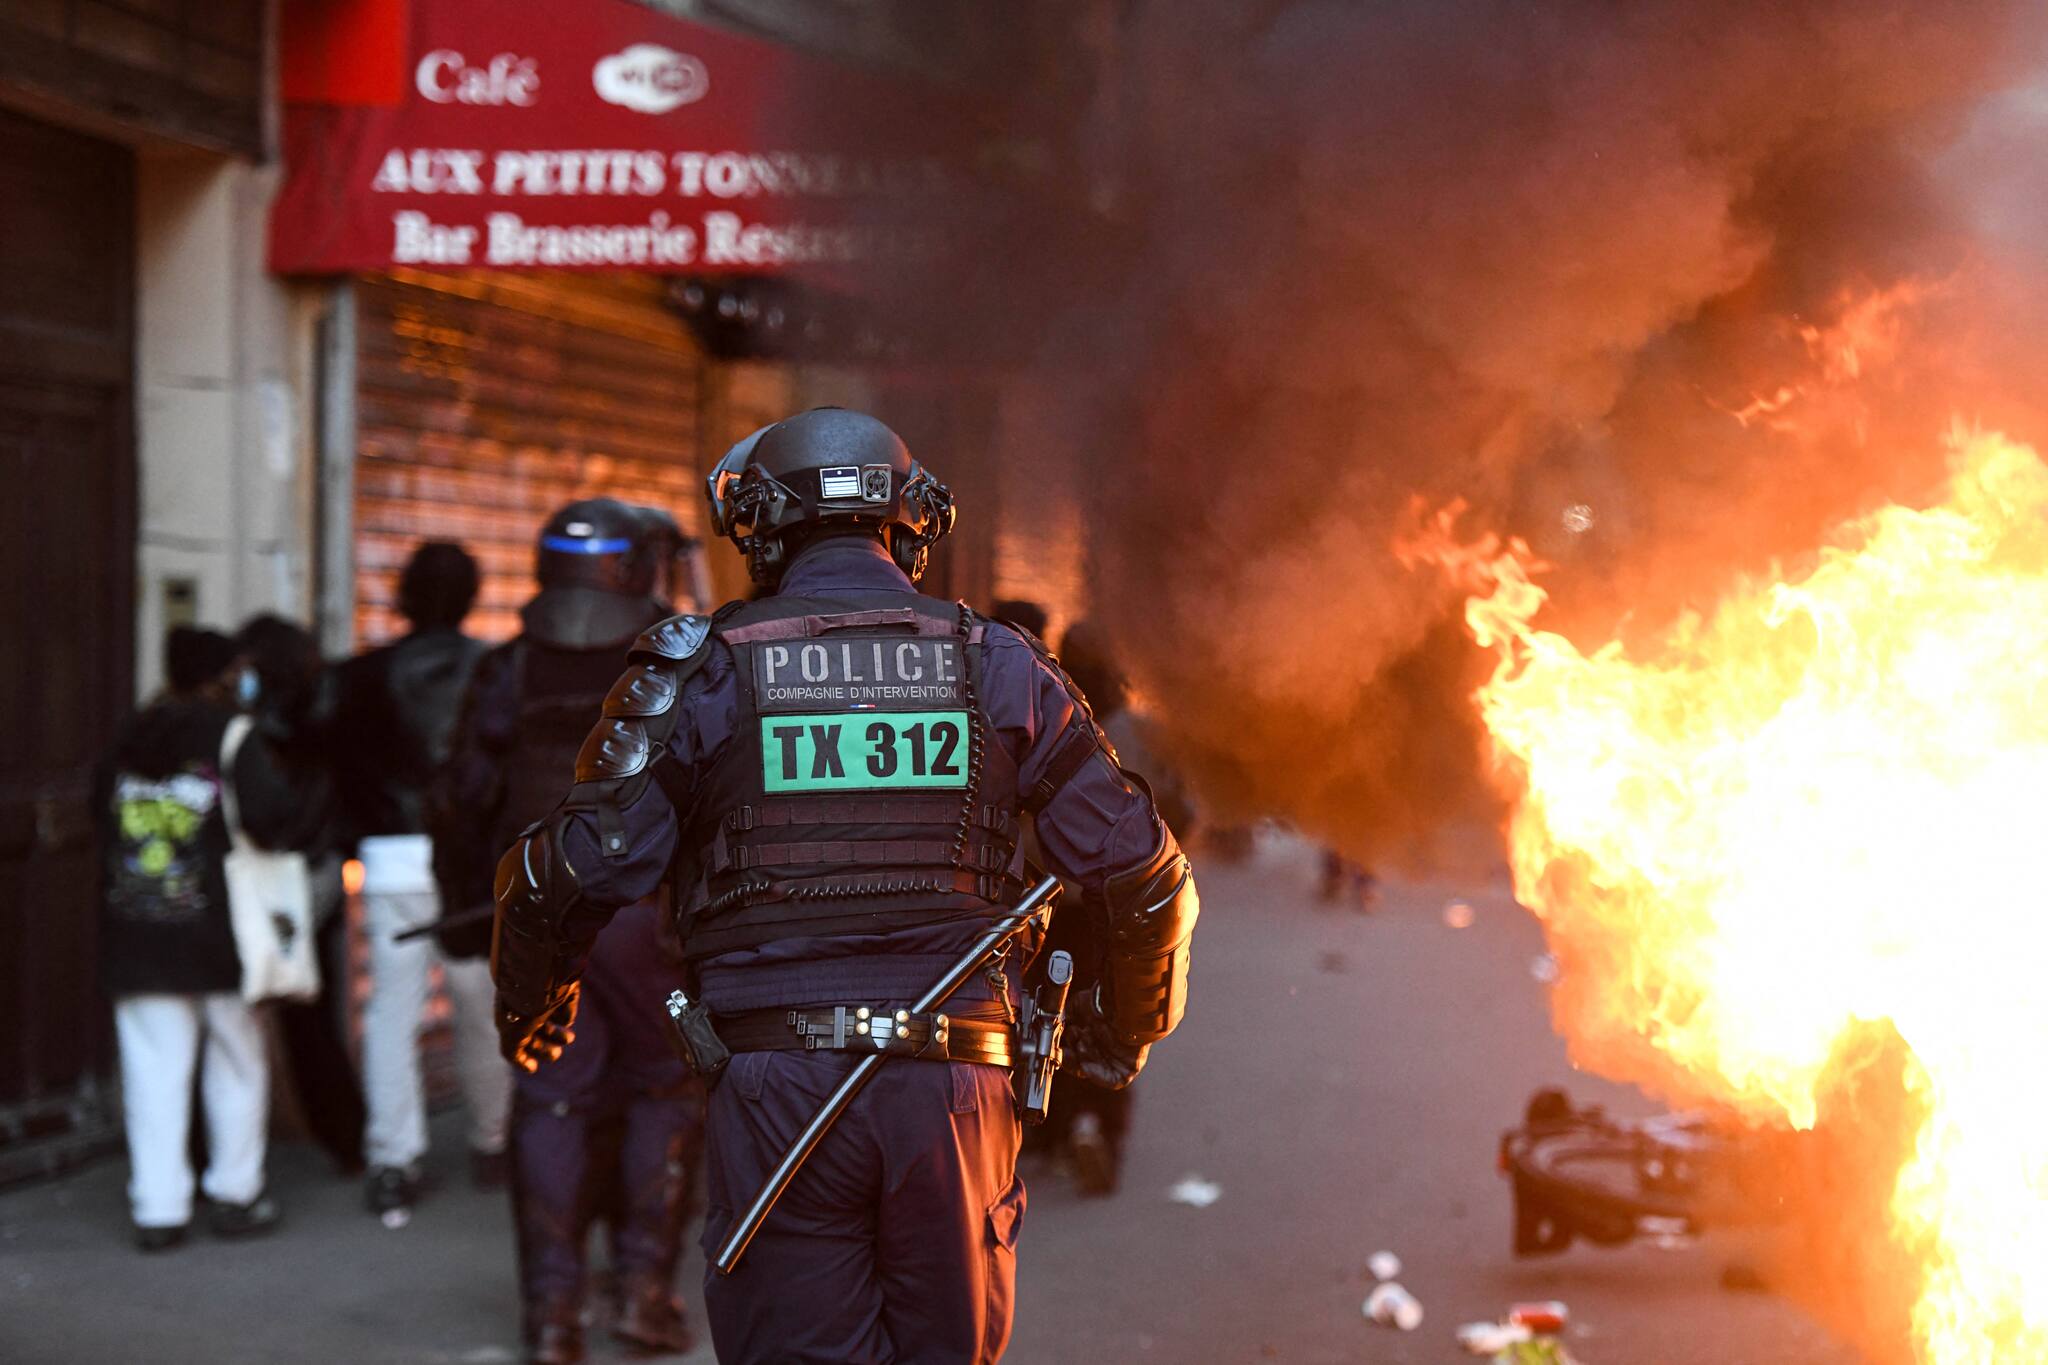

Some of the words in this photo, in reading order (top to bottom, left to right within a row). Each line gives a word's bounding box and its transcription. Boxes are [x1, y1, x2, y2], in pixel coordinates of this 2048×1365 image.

[416, 49, 540, 107] Café
[372, 149, 484, 194] AUX
[493, 150, 667, 195] PETITS
[672, 151, 900, 197] TONNE
[392, 210, 478, 264] Bar
[485, 210, 698, 265] Brasserie
[703, 210, 880, 265] Resta
[765, 643, 957, 684] POLICE
[767, 686, 845, 700] COMPAGNIE
[850, 685, 957, 699] D'INTERVENTION
[773, 724, 846, 780] TX
[865, 721, 960, 778] 312
